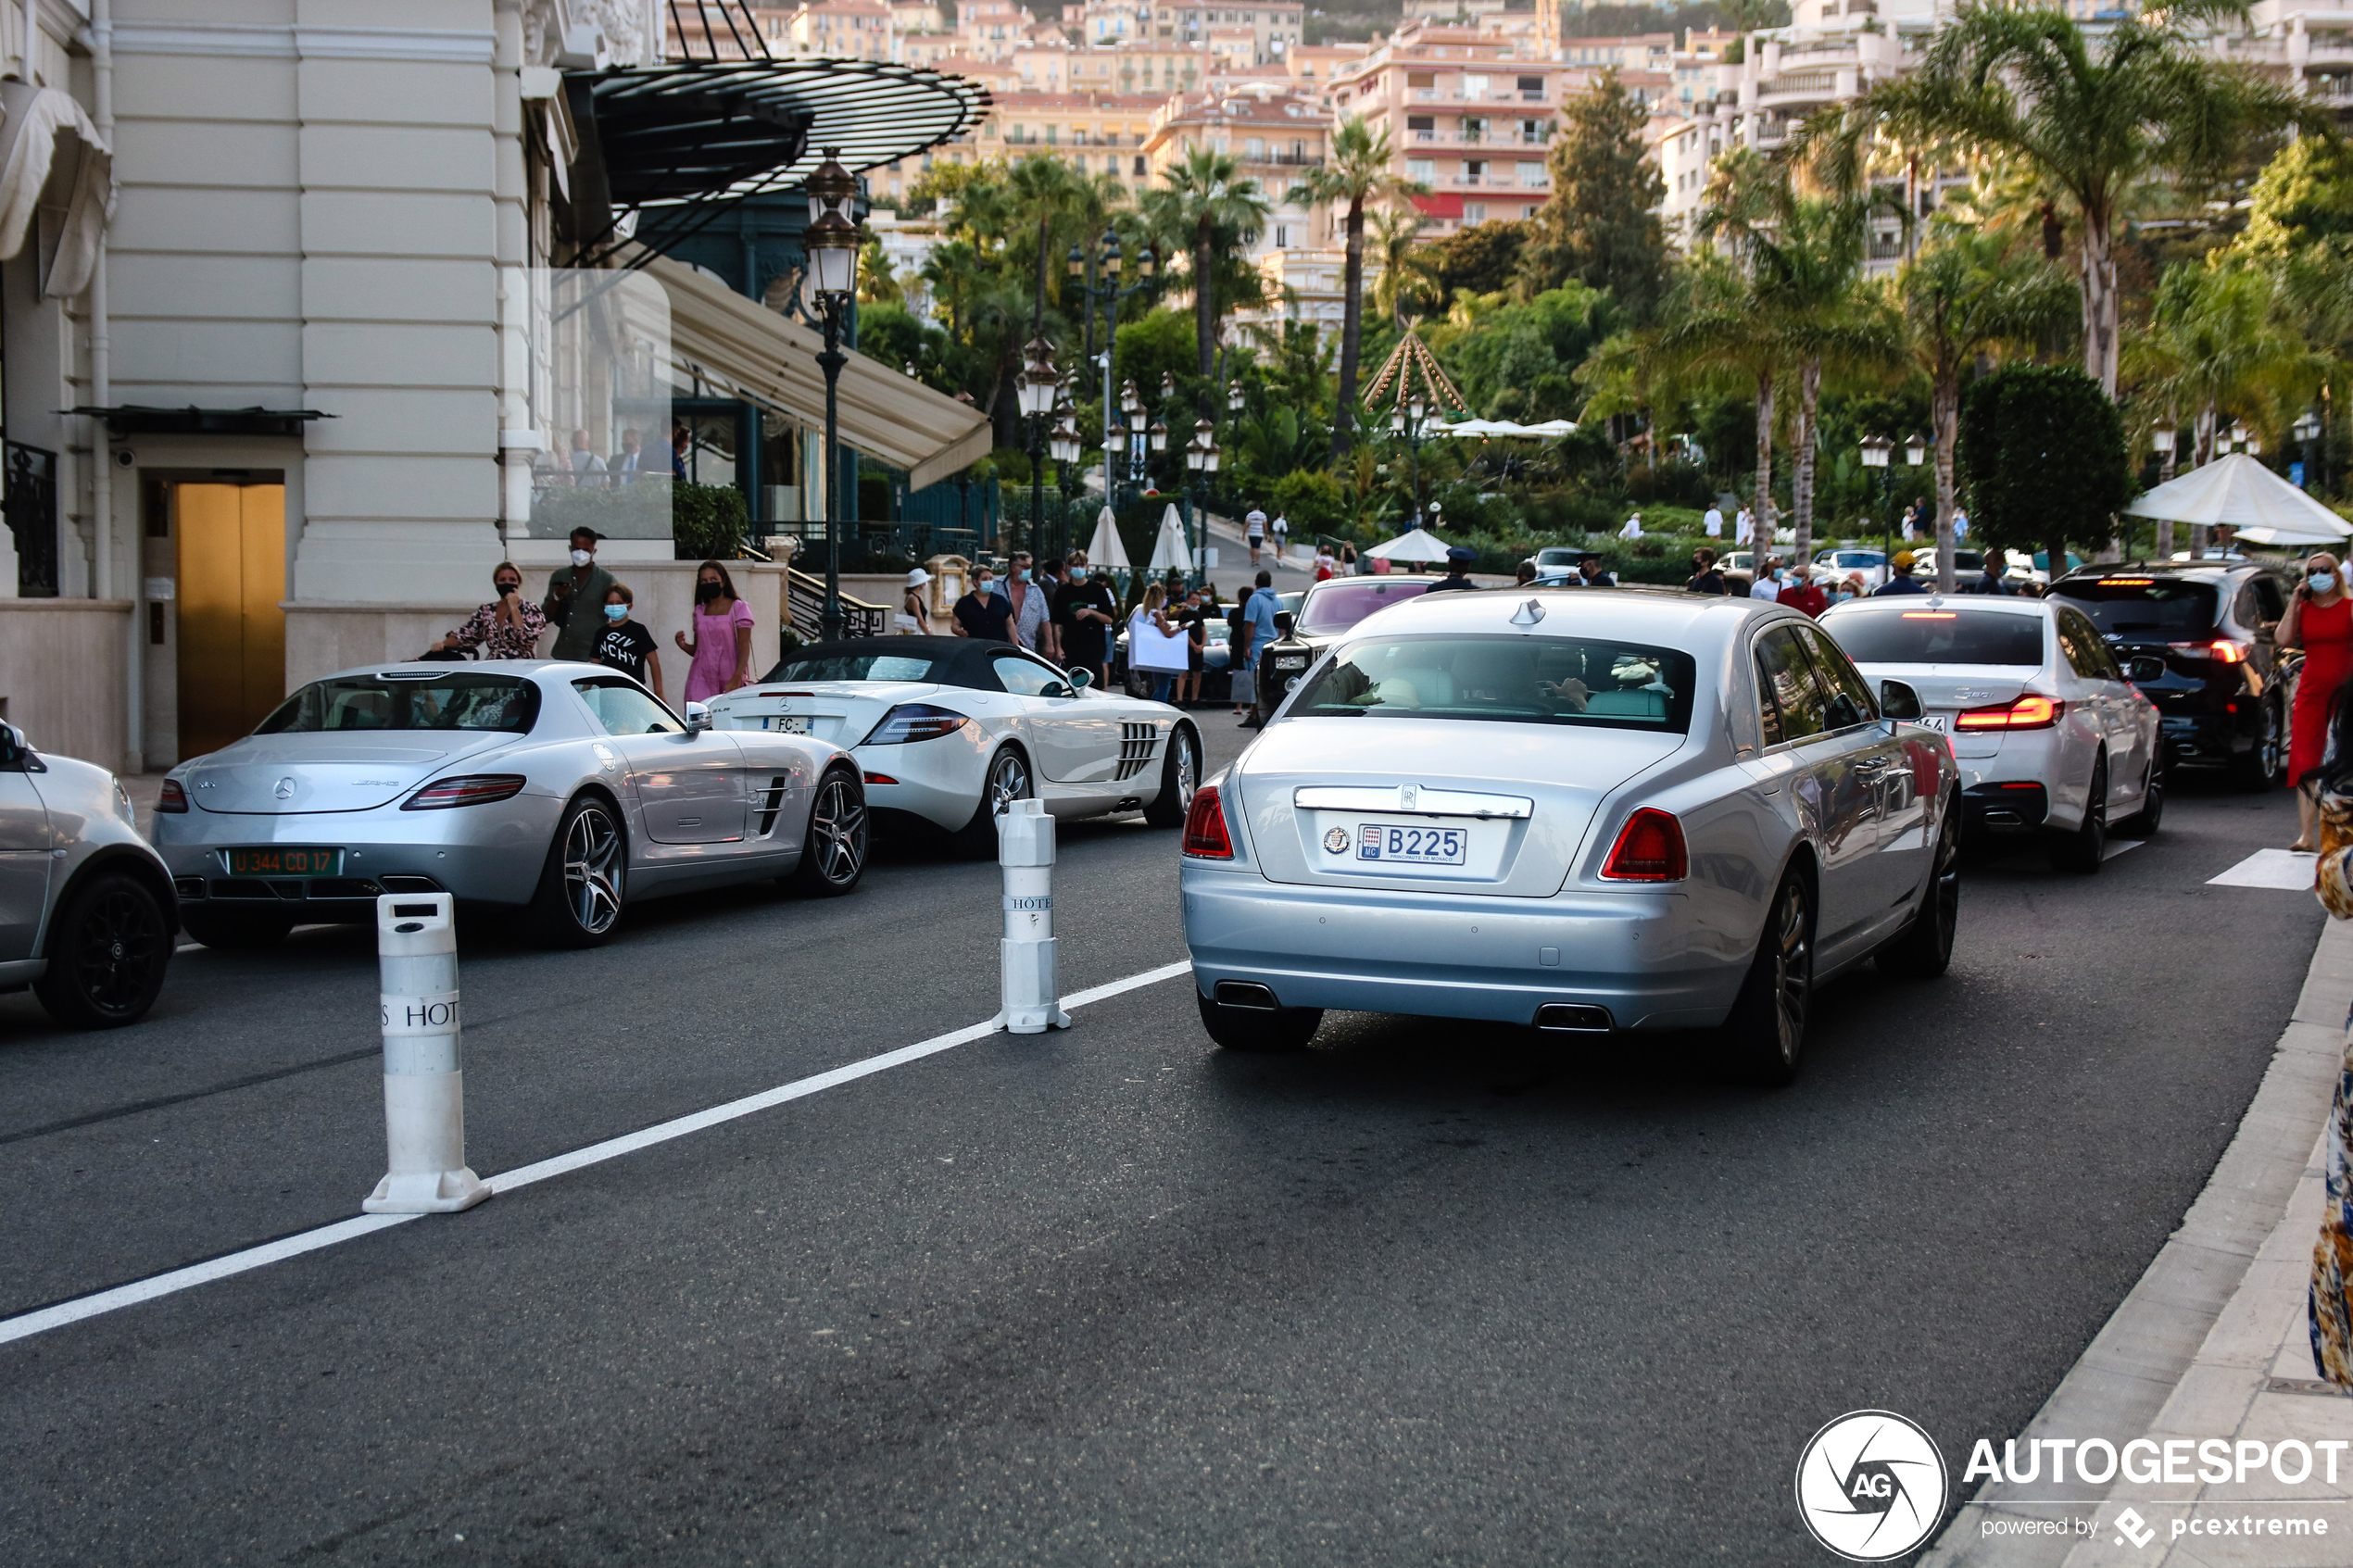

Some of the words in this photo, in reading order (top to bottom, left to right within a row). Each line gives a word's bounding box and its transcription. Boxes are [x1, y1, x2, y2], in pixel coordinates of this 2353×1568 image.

[606, 632, 636, 647] GIV
[1389, 829, 1458, 857] B225
[1365, 847, 1377, 857] MC
[250, 853, 281, 872] 344
[285, 852, 308, 872] CD
[313, 852, 332, 872] 17
